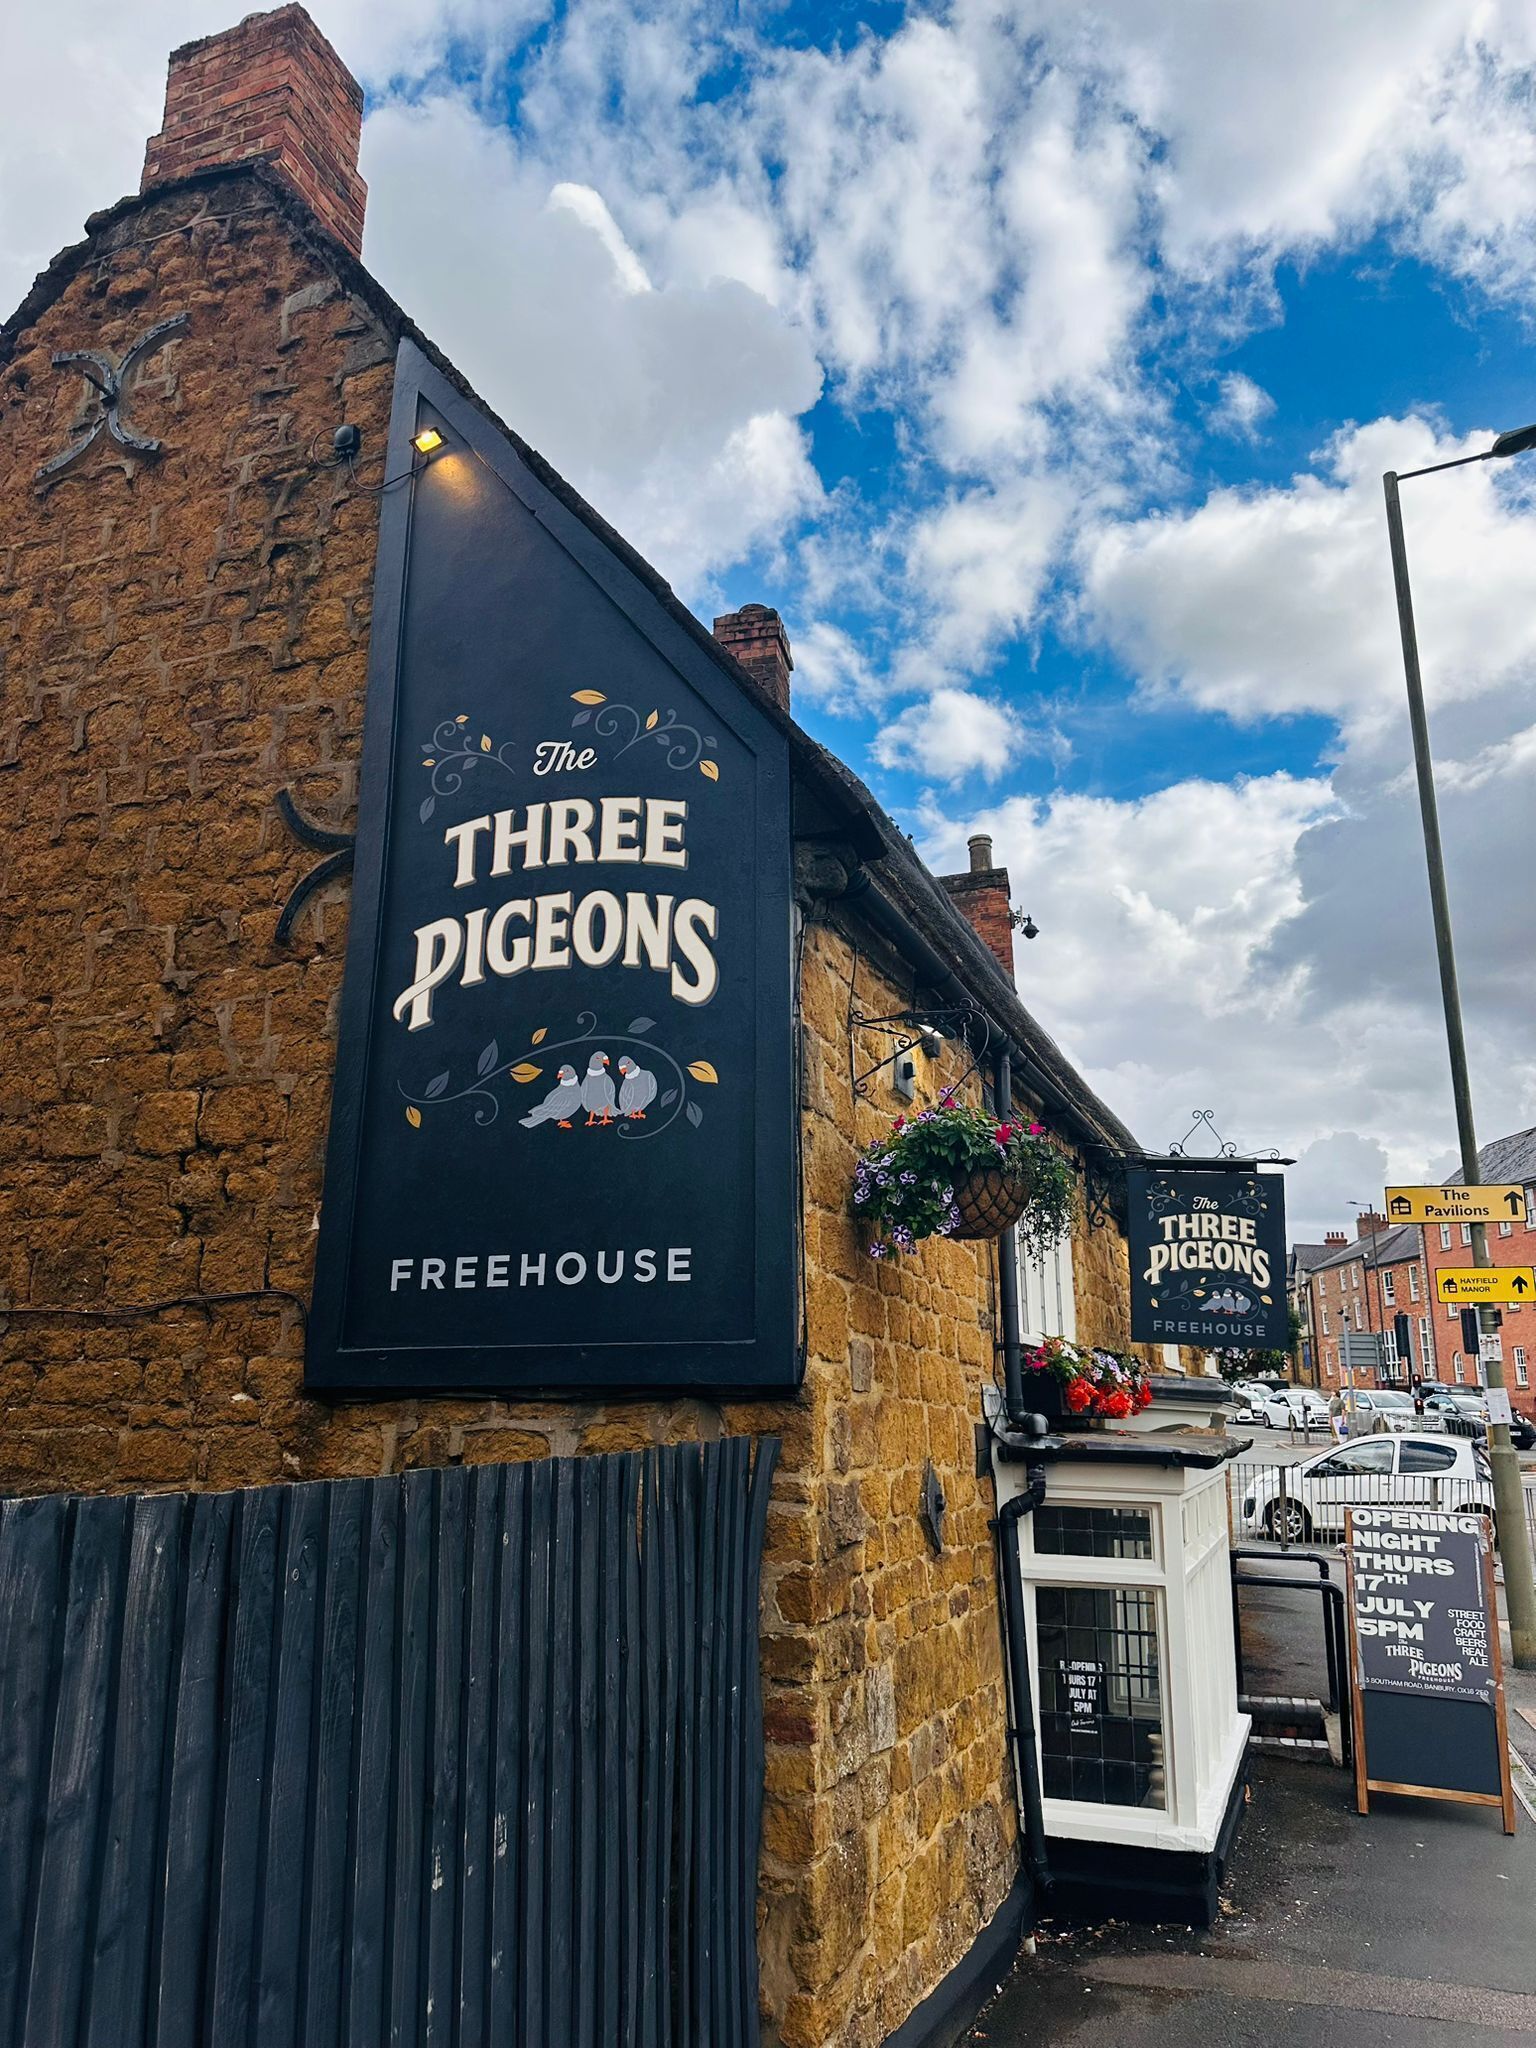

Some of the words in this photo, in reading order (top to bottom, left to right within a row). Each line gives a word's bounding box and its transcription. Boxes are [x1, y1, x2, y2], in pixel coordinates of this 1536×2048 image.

[532, 741, 597, 776] The
[444, 796, 688, 889] THREE
[393, 890, 719, 1032] PIGEONS
[1192, 1196, 1219, 1210] The
[1440, 1189, 1470, 1201] The
[1424, 1204, 1490, 1217] Pavilions
[1158, 1213, 1257, 1246] THREE
[390, 1247, 692, 1292] FREEHOUSE
[1143, 1240, 1271, 1289] PIGEONS
[1153, 1319, 1266, 1337] FREEHOUSE
[1351, 1509, 1479, 1535] OPENING
[1352, 1529, 1441, 1553] NIGHT
[1353, 1552, 1455, 1576] THURS
[1356, 1596, 1435, 1619] JULY
[1447, 1609, 1485, 1620] STREET
[1357, 1617, 1424, 1641] 5PM
[1456, 1619, 1486, 1630] FOOD
[1453, 1628, 1487, 1639] CRAFT
[1455, 1637, 1488, 1648] BEERS
[1385, 1645, 1424, 1661] THREE
[1461, 1646, 1489, 1658] REAL
[1060, 1660, 1103, 1673] R-OPENING
[1408, 1659, 1463, 1681] PIGEONS
[1468, 1657, 1489, 1667] ALE
[1069, 1687, 1086, 1699] JULY
[1087, 1689, 1097, 1700] AT
[1073, 1701, 1093, 1714] 5PM
